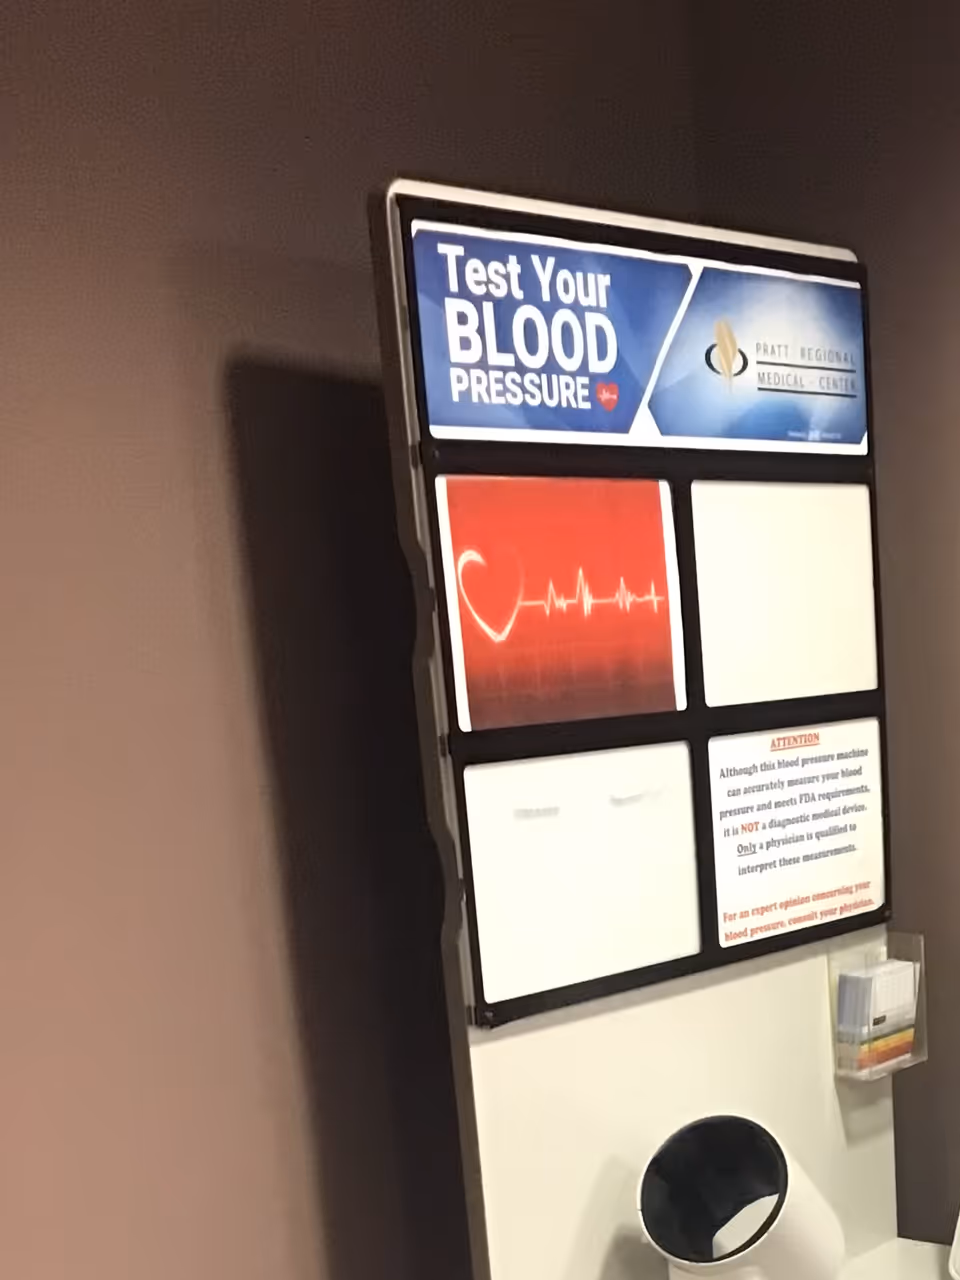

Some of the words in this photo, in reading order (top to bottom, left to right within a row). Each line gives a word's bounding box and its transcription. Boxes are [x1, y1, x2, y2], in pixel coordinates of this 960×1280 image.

[437, 243, 524, 300] Test
[530, 254, 611, 308] Your
[445, 297, 618, 374] BLOOD
[756, 342, 789, 358] PRATT
[800, 347, 856, 367] REGIONAL
[449, 367, 591, 409] PRESSURE
[757, 372, 805, 388] MEDICAL
[819, 376, 857, 392] CENTER
[770, 732, 820, 751] ATTENTION
[719, 763, 758, 779] Although
[760, 761, 776, 773] this
[778, 757, 799, 769] blood
[801, 753, 835, 767] pressure
[836, 748, 869, 760] machine
[727, 787, 741, 797] can
[743, 779, 785, 794] accurately
[787, 776, 819, 788] measure
[821, 772, 840, 784] your
[841, 766, 863, 778] blood
[719, 805, 754, 821] pressure
[756, 799, 772, 812] and
[774, 797, 797, 809] meets
[799, 792, 816, 804] FDA
[723, 827, 730, 838] it
[732, 826, 739, 836] is
[740, 821, 760, 834] NOT
[761, 822, 767, 830] a
[768, 813, 810, 829] diagnostic
[811, 806, 841, 821] medical
[842, 803, 867, 816] device.
[737, 842, 757, 857] Only
[759, 842, 764, 851] a
[765, 834, 805, 851] physician
[806, 831, 813, 841] is
[814, 824, 848, 841] qualified
[849, 823, 857, 832] to
[738, 859, 777, 876] interpret
[778, 854, 800, 868] these
[723, 912, 737, 924] For
[739, 910, 750, 919] an
[751, 903, 778, 918] expert
[779, 895, 811, 911] opinion
[812, 884, 854, 902] concerning
[855, 881, 871, 892] your
[724, 927, 748, 942] blood
[788, 911, 818, 925] consult
[819, 906, 838, 920] your
